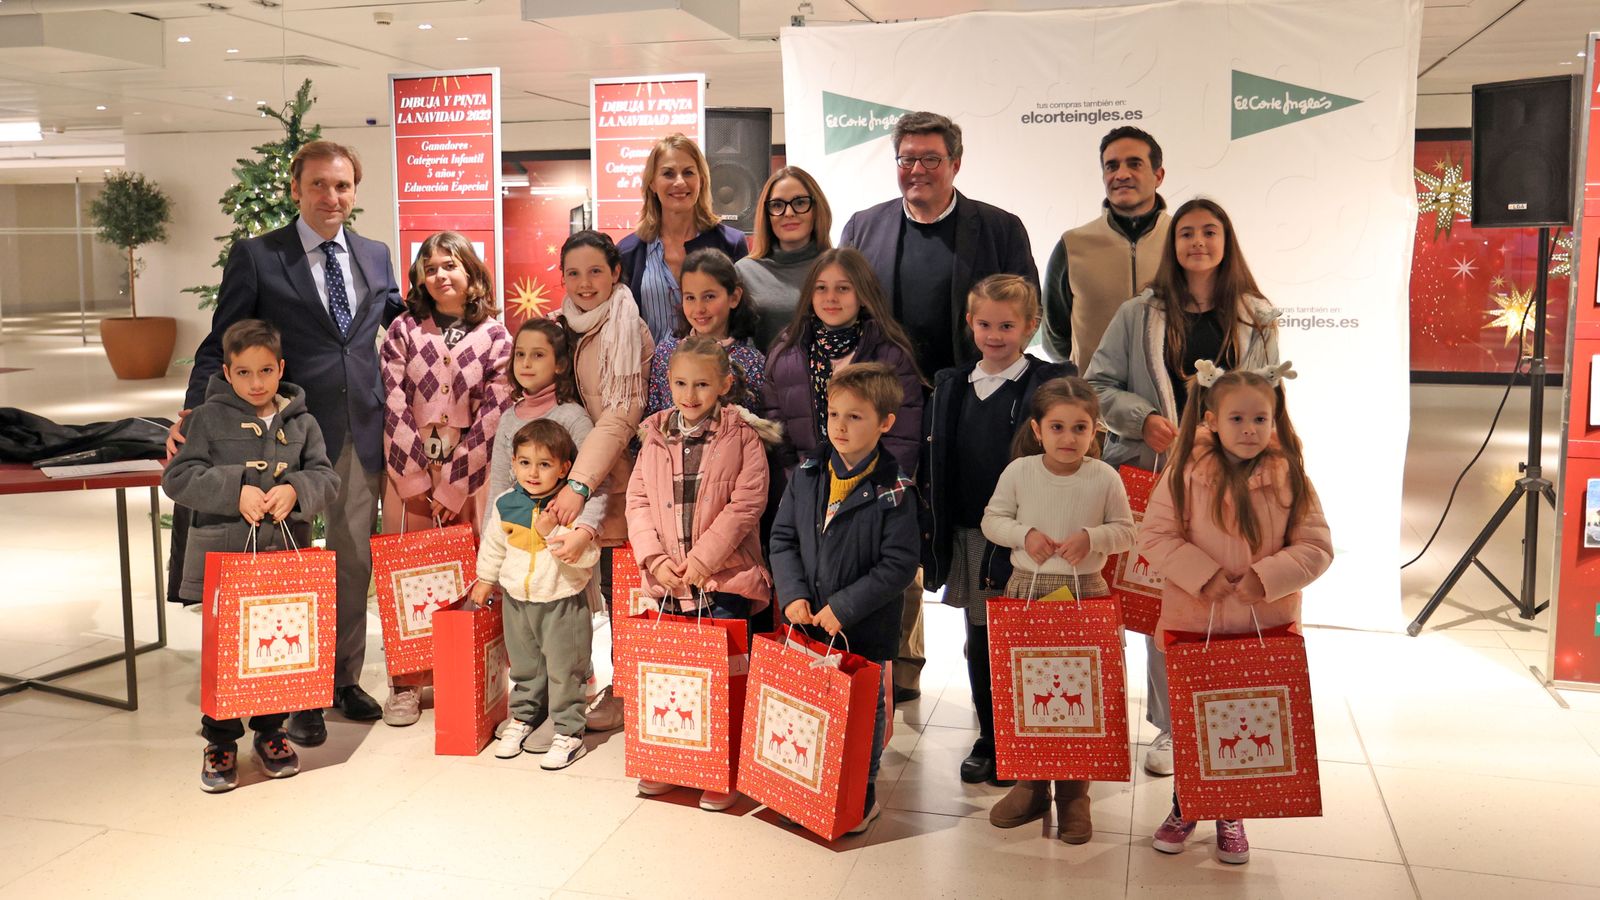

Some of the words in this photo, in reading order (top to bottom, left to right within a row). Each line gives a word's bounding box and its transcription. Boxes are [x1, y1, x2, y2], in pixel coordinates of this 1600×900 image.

[400, 95, 440, 108] DIBUJA
[444, 96, 452, 106] Y
[453, 94, 486, 107] PINTA
[602, 100, 644, 112] DIBUJA
[648, 100, 655, 110] Y
[657, 98, 693, 111] PINTA
[1049, 101, 1081, 110] compras
[1083, 99, 1113, 107] también
[1234, 96, 1248, 110] El
[1248, 96, 1282, 110] Corte
[1283, 91, 1332, 115] Inglés
[397, 112, 412, 124] LA
[414, 111, 464, 123] NAVIDAD
[598, 115, 614, 127] LA
[616, 114, 670, 126] NAVIDAD
[825, 114, 838, 128] El
[839, 114, 867, 128] Corte
[868, 109, 905, 131] Inglé
[1021, 109, 1143, 125] elcorteingles.es
[421, 140, 469, 151] Ganadores
[407, 154, 448, 167] Categoría
[451, 153, 484, 166] Infantil
[427, 168, 433, 178] 5
[435, 168, 456, 178] años
[457, 170, 464, 180] y
[605, 161, 645, 176] Categor
[404, 182, 449, 193] Educación
[451, 181, 488, 194] Especial
[617, 177, 629, 188] de
[1278, 315, 1359, 331] eingles.es
